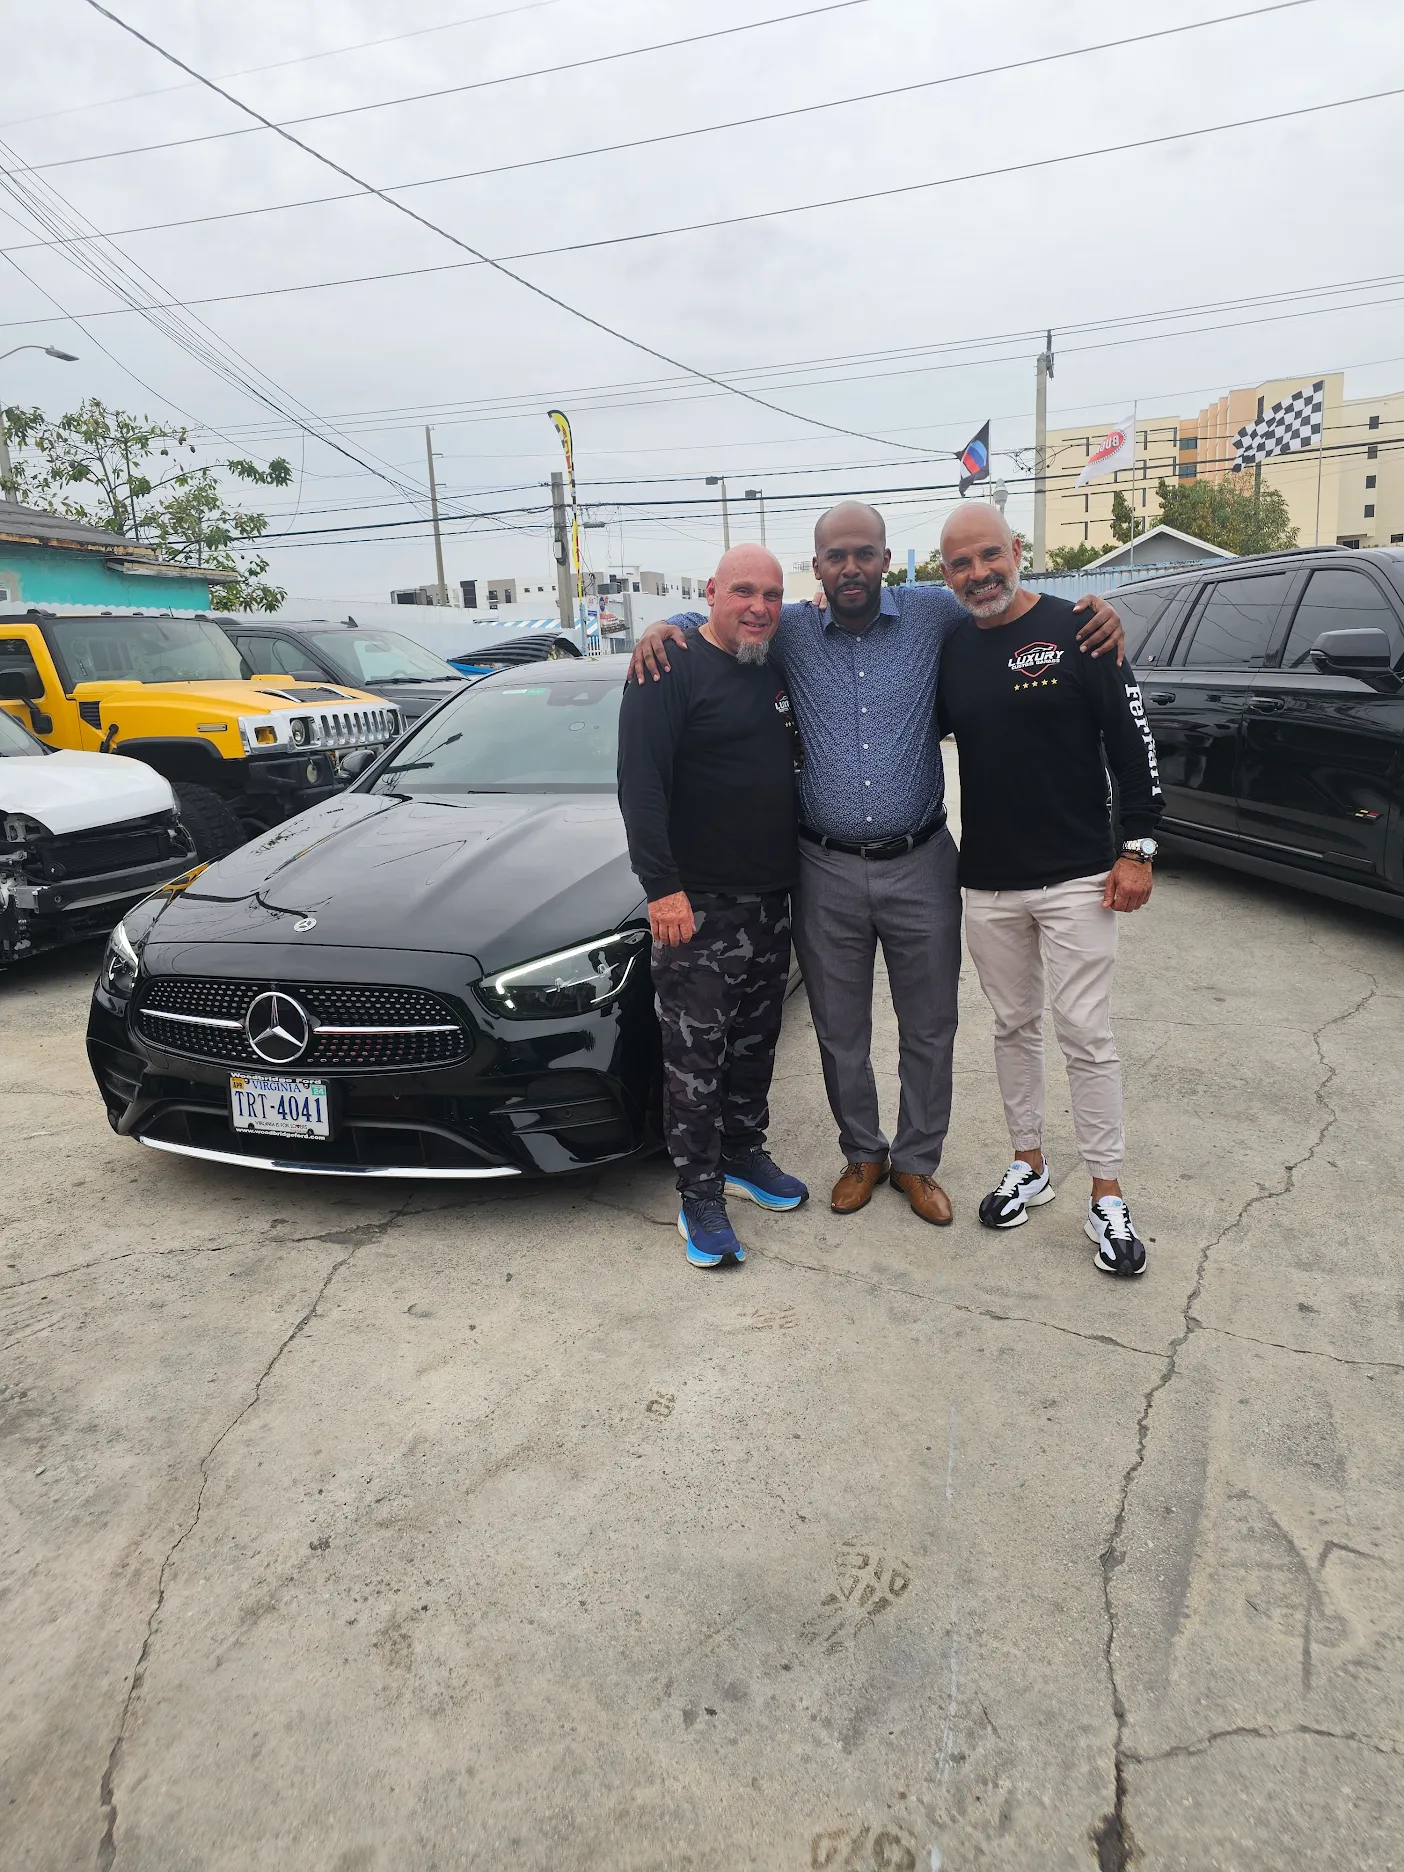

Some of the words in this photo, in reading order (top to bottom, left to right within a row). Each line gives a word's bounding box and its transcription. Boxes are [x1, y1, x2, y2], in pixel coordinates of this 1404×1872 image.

[1008, 650, 1065, 668] LUXURY
[230, 1072, 293, 1083] Woodbridge
[232, 1081, 243, 1089] APR
[252, 1080, 302, 1093] VIRGINIA
[313, 1087, 325, 1095] 24
[234, 1090, 324, 1124] TRT-4041
[236, 1128, 326, 1141] www.woodbridgeford.com
